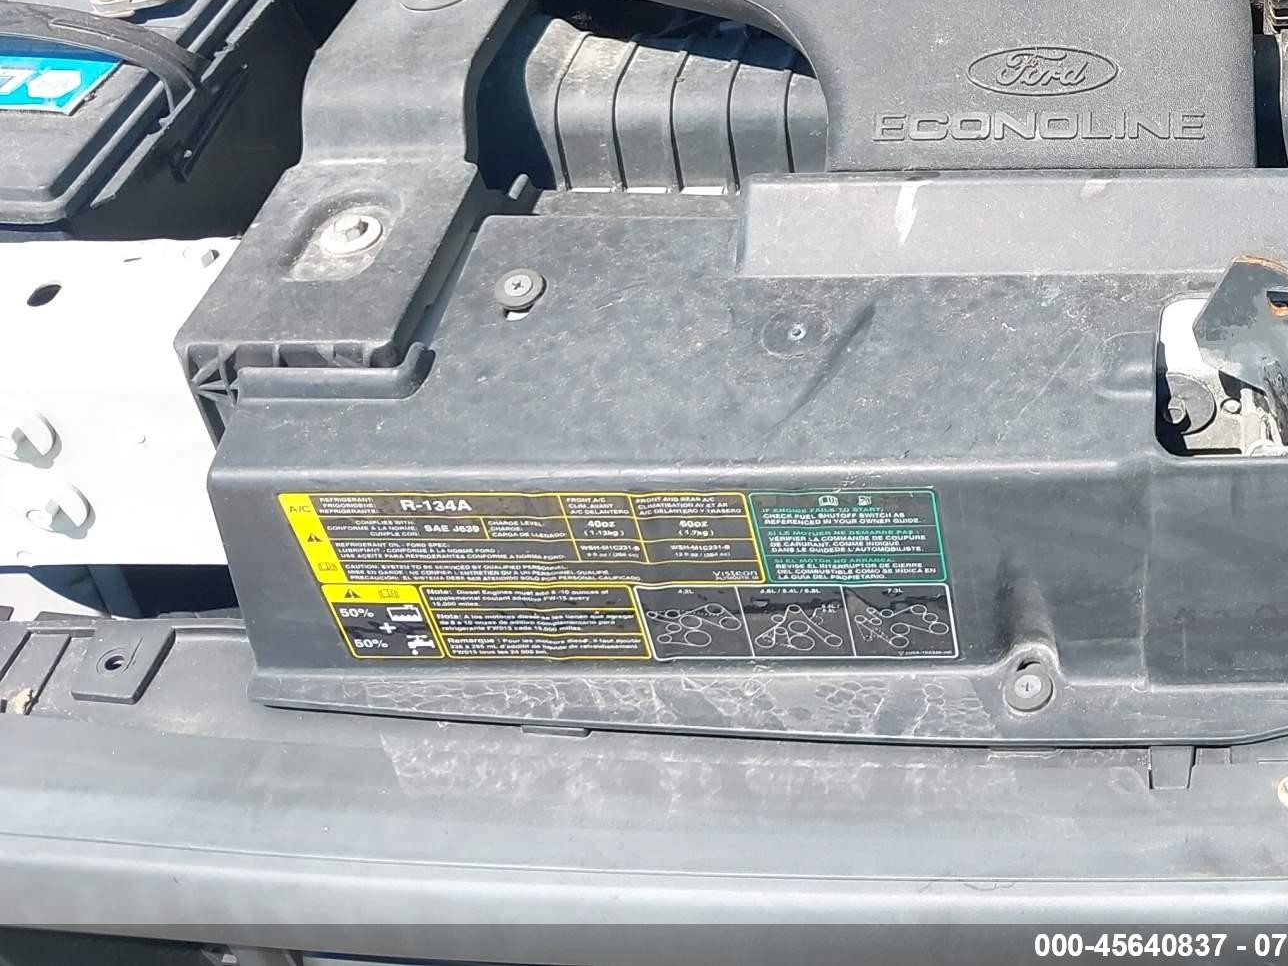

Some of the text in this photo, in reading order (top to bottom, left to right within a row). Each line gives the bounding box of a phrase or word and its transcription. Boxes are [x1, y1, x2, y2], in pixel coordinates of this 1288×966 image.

[996, 50, 1089, 87] Ford
[872, 110, 1206, 141] ECONOLINE
[400, 499, 472, 512] R-134A
[339, 608, 375, 618] 50%
[353, 639, 389, 648] 50%
